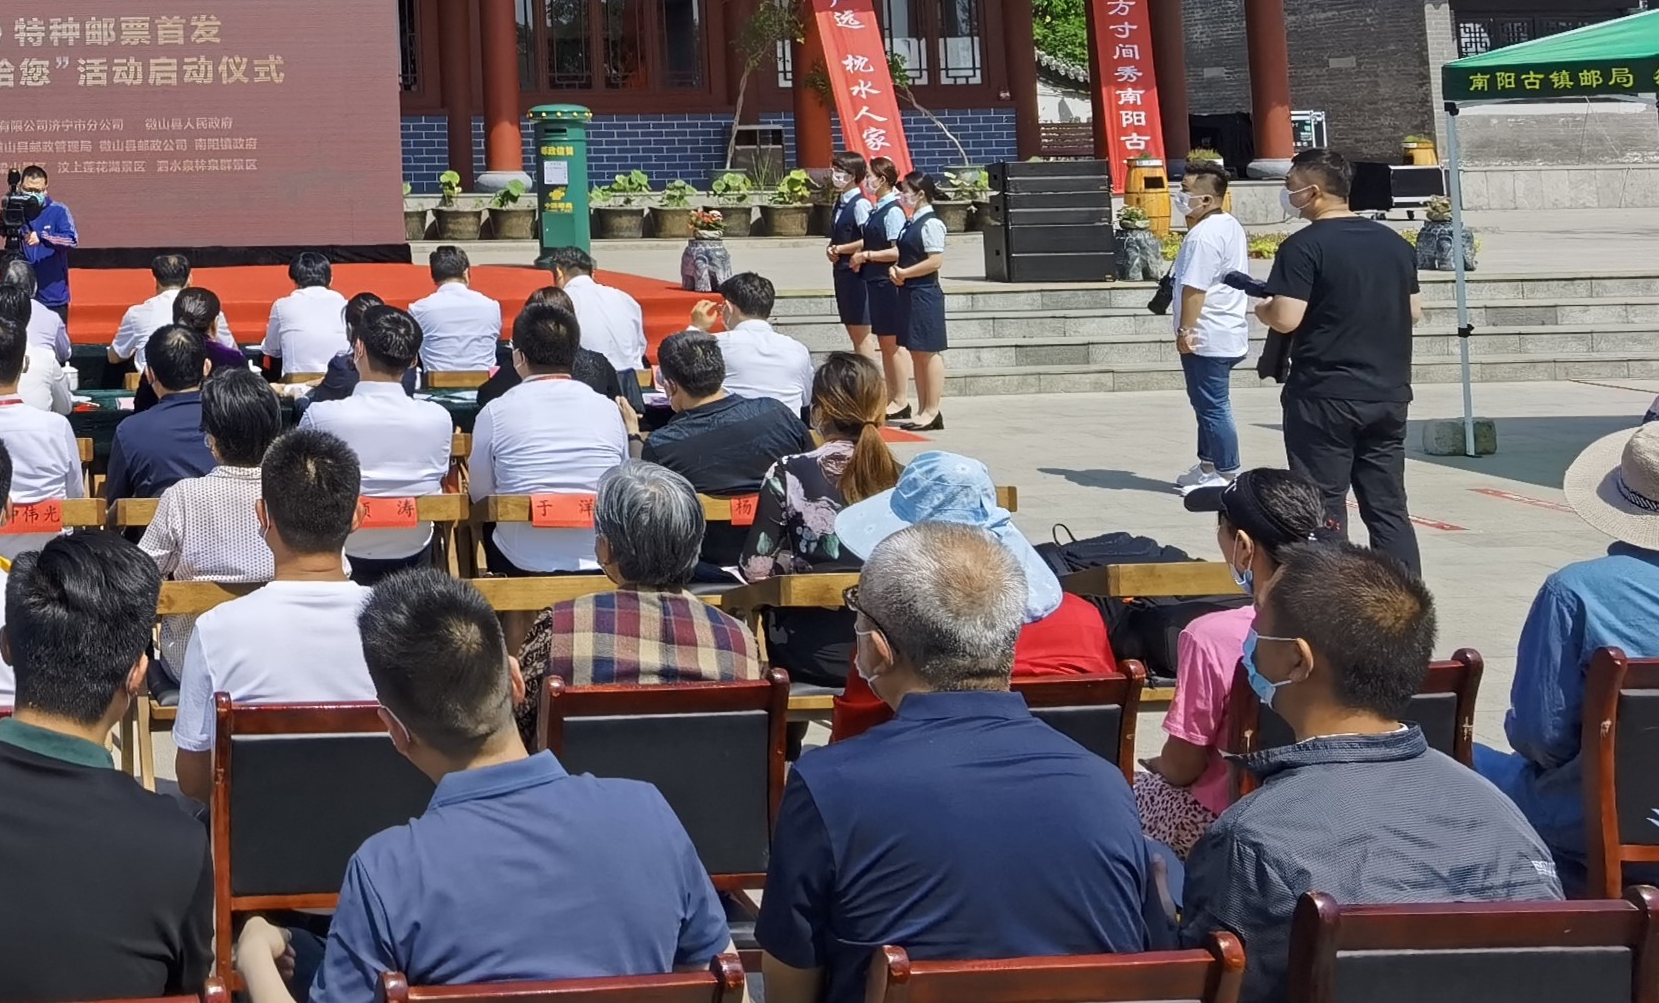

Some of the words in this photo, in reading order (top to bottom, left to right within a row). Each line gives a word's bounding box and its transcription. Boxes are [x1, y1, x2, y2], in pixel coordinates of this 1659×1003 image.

[841, 53, 893, 161] 枕水人家
[1468, 67, 1634, 91] 南阳古镇邮局
